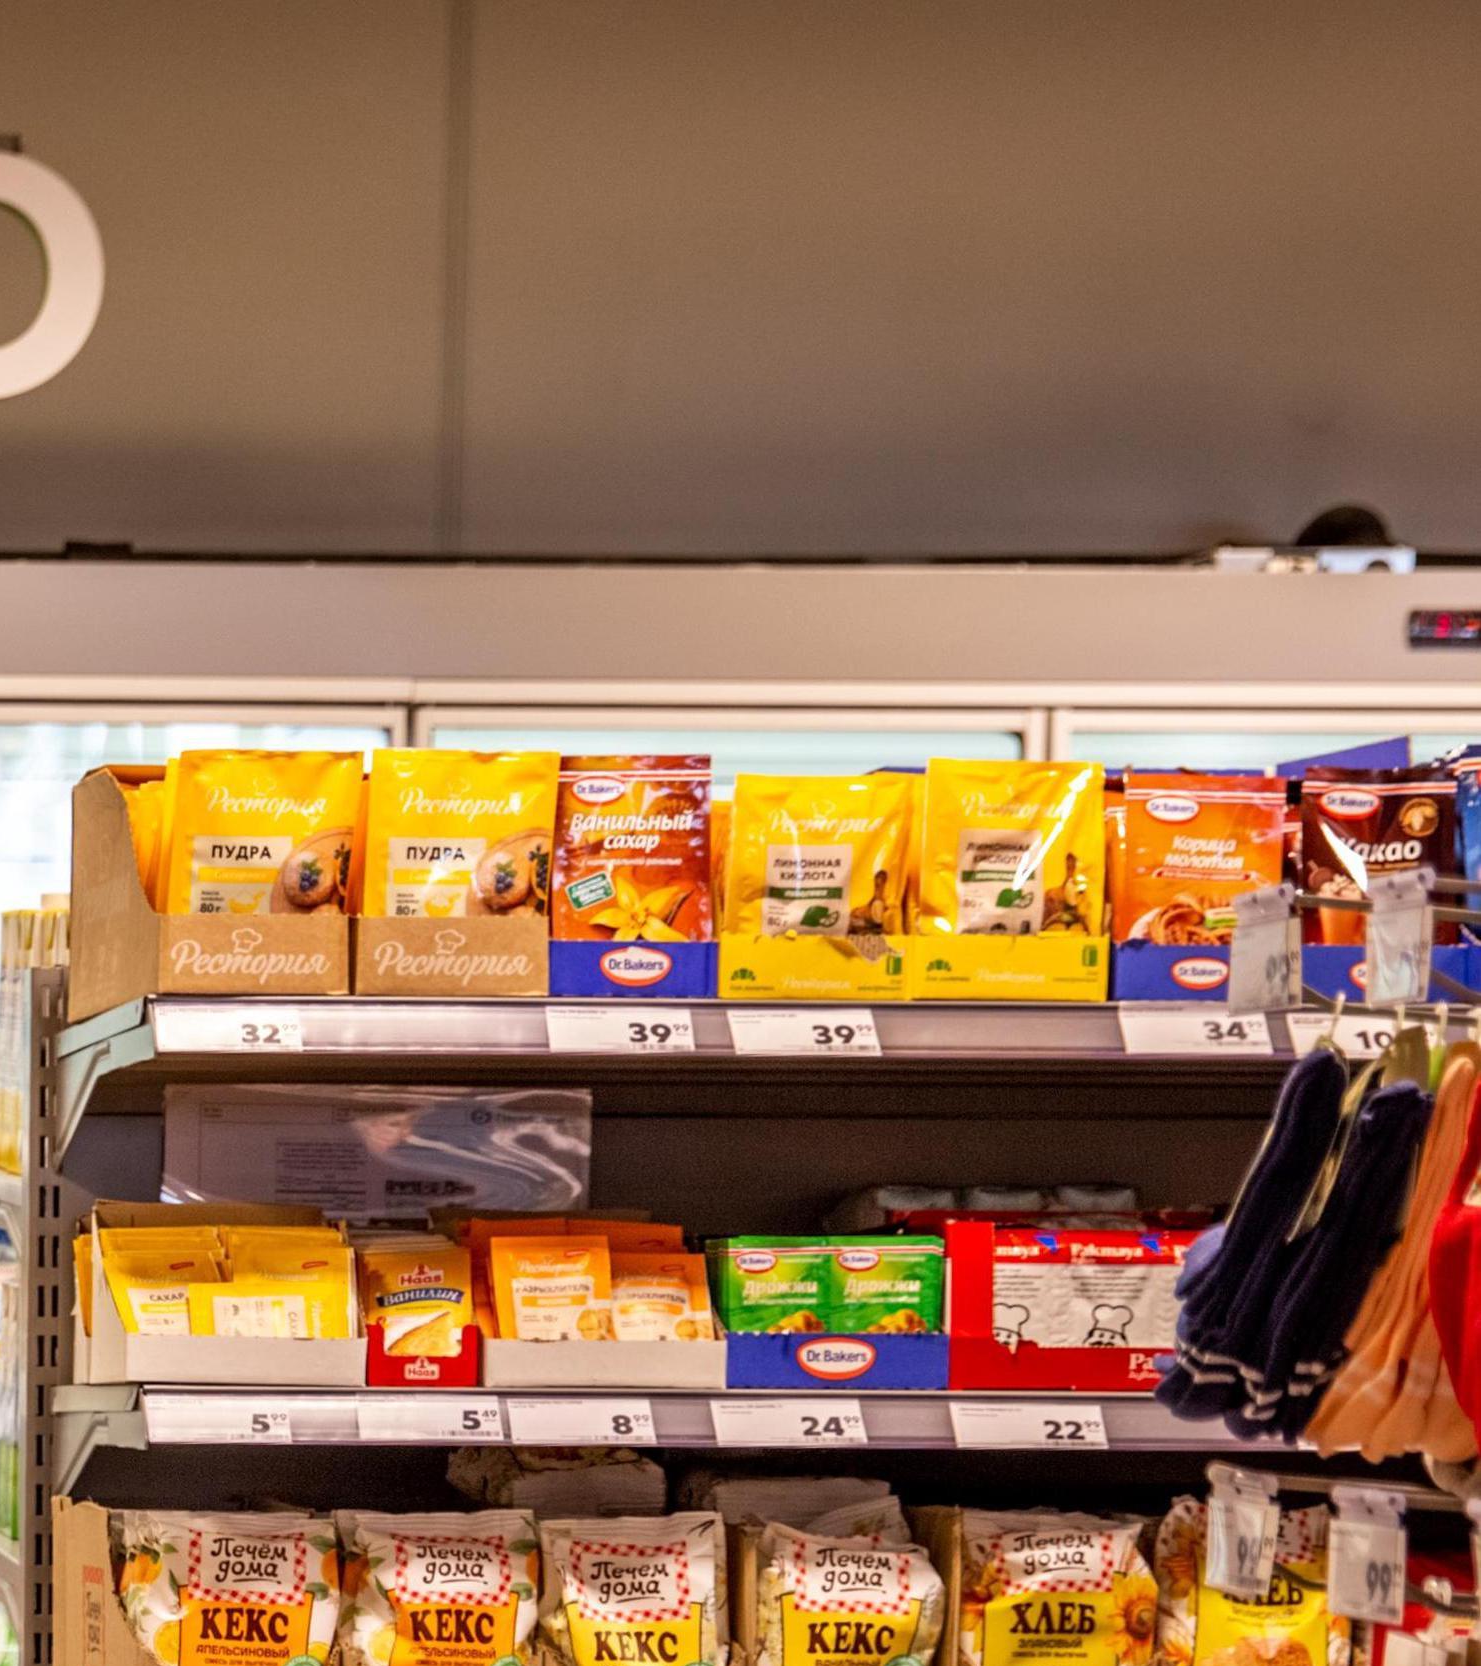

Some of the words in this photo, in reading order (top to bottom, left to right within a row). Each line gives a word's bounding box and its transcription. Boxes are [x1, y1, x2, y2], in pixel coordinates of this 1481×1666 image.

[211, 846, 272, 861] ПУДРА
[603, 834, 660, 852] сахар
[1172, 835, 1237, 856] Корица
[406, 846, 465, 862] ПУДРА
[773, 858, 842, 870] ЛИМОННАЯ
[1164, 853, 1244, 871] молотая
[779, 870, 836, 882] КИСЛОТА
[170, 940, 331, 984] Рестория
[241, 1024, 281, 1044] 32
[628, 1023, 671, 1044] 39
[1203, 1021, 1247, 1042] 34
[400, 1271, 443, 1286] Haas
[149, 1293, 186, 1303] САХАР
[251, 1413, 270, 1434] 5
[462, 1410, 480, 1430] 5
[612, 1414, 633, 1435] 8
[801, 1416, 844, 1437] 24
[1043, 1420, 1085, 1441] 22
[210, 1536, 289, 1563] Печём
[215, 1558, 280, 1584] дома
[1023, 1549, 1087, 1573] дома
[598, 1578, 662, 1603] дома
[200, 1608, 290, 1643] КЕКС
[410, 1609, 494, 1644] КЕКС
[1011, 1602, 1096, 1636] ХЛЕБ
[594, 1630, 678, 1663] КЕКС
[807, 1621, 896, 1655] КЕКС
[195, 1645, 291, 1658] АПЕЛЬСИНОВЫЙ
